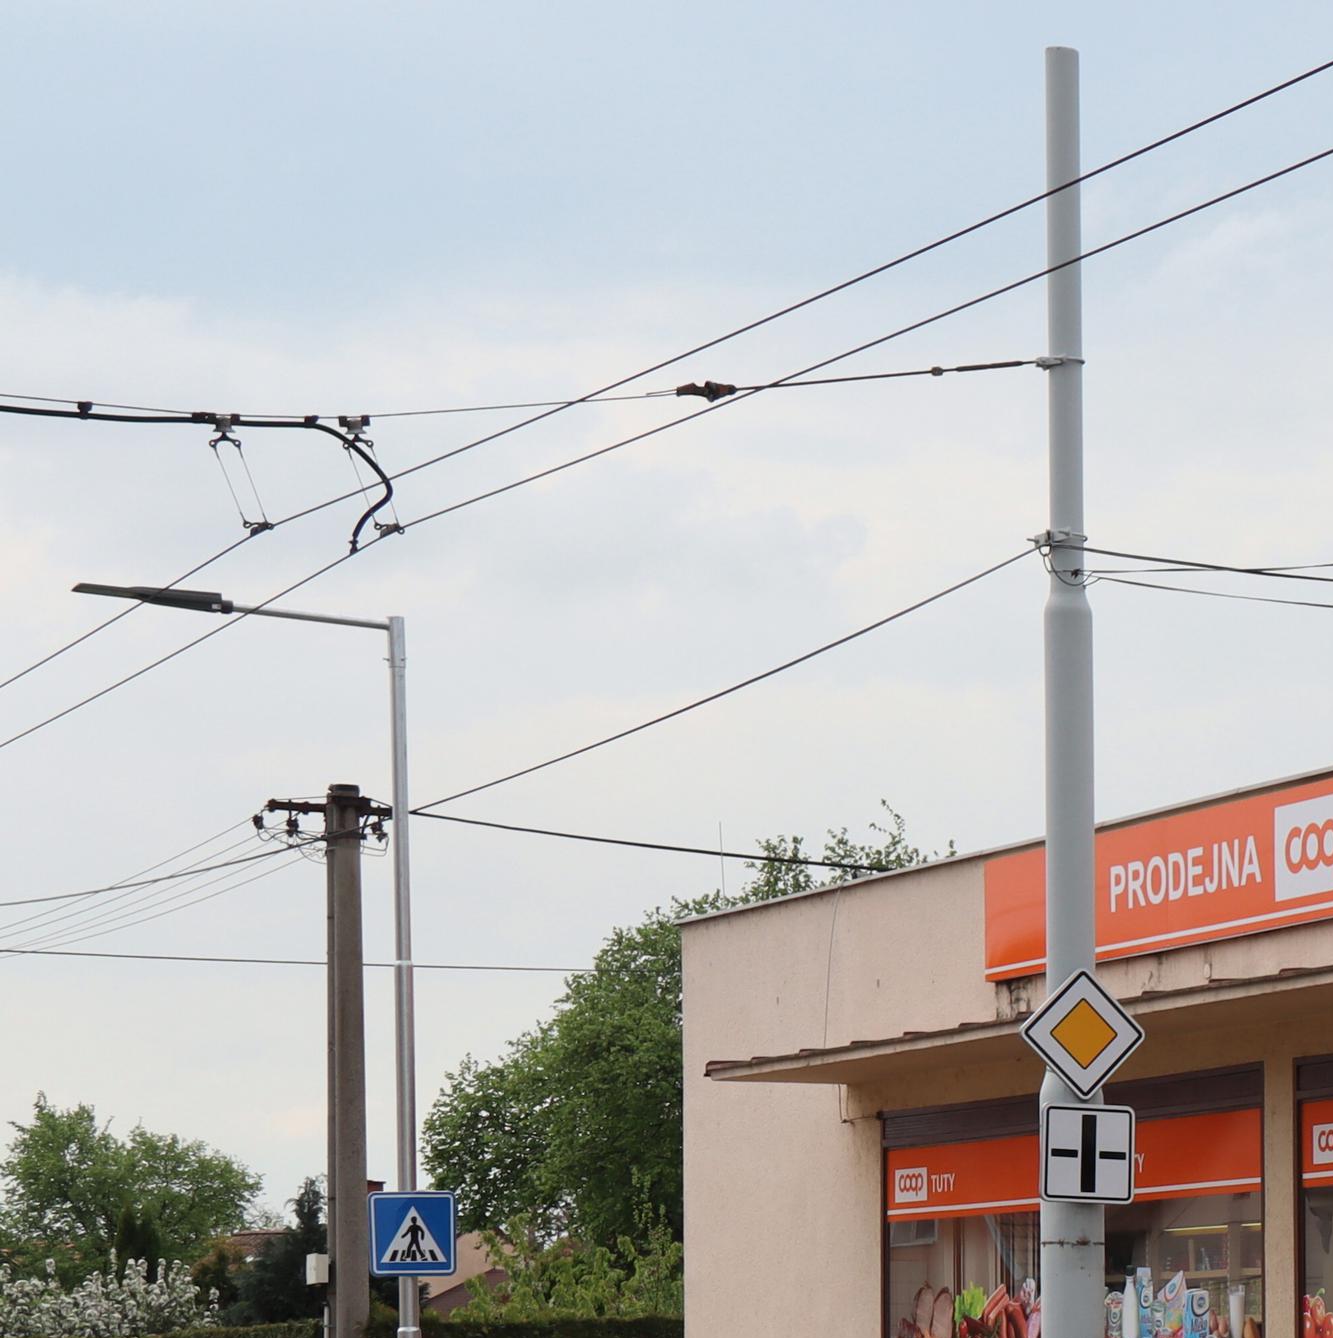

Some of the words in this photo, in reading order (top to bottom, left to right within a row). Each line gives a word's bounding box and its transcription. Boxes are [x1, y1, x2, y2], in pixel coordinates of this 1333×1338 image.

[1110, 835, 1262, 912] PRODEJNA
[899, 1172, 924, 1197] coop
[930, 1173, 956, 1193] TUTY
